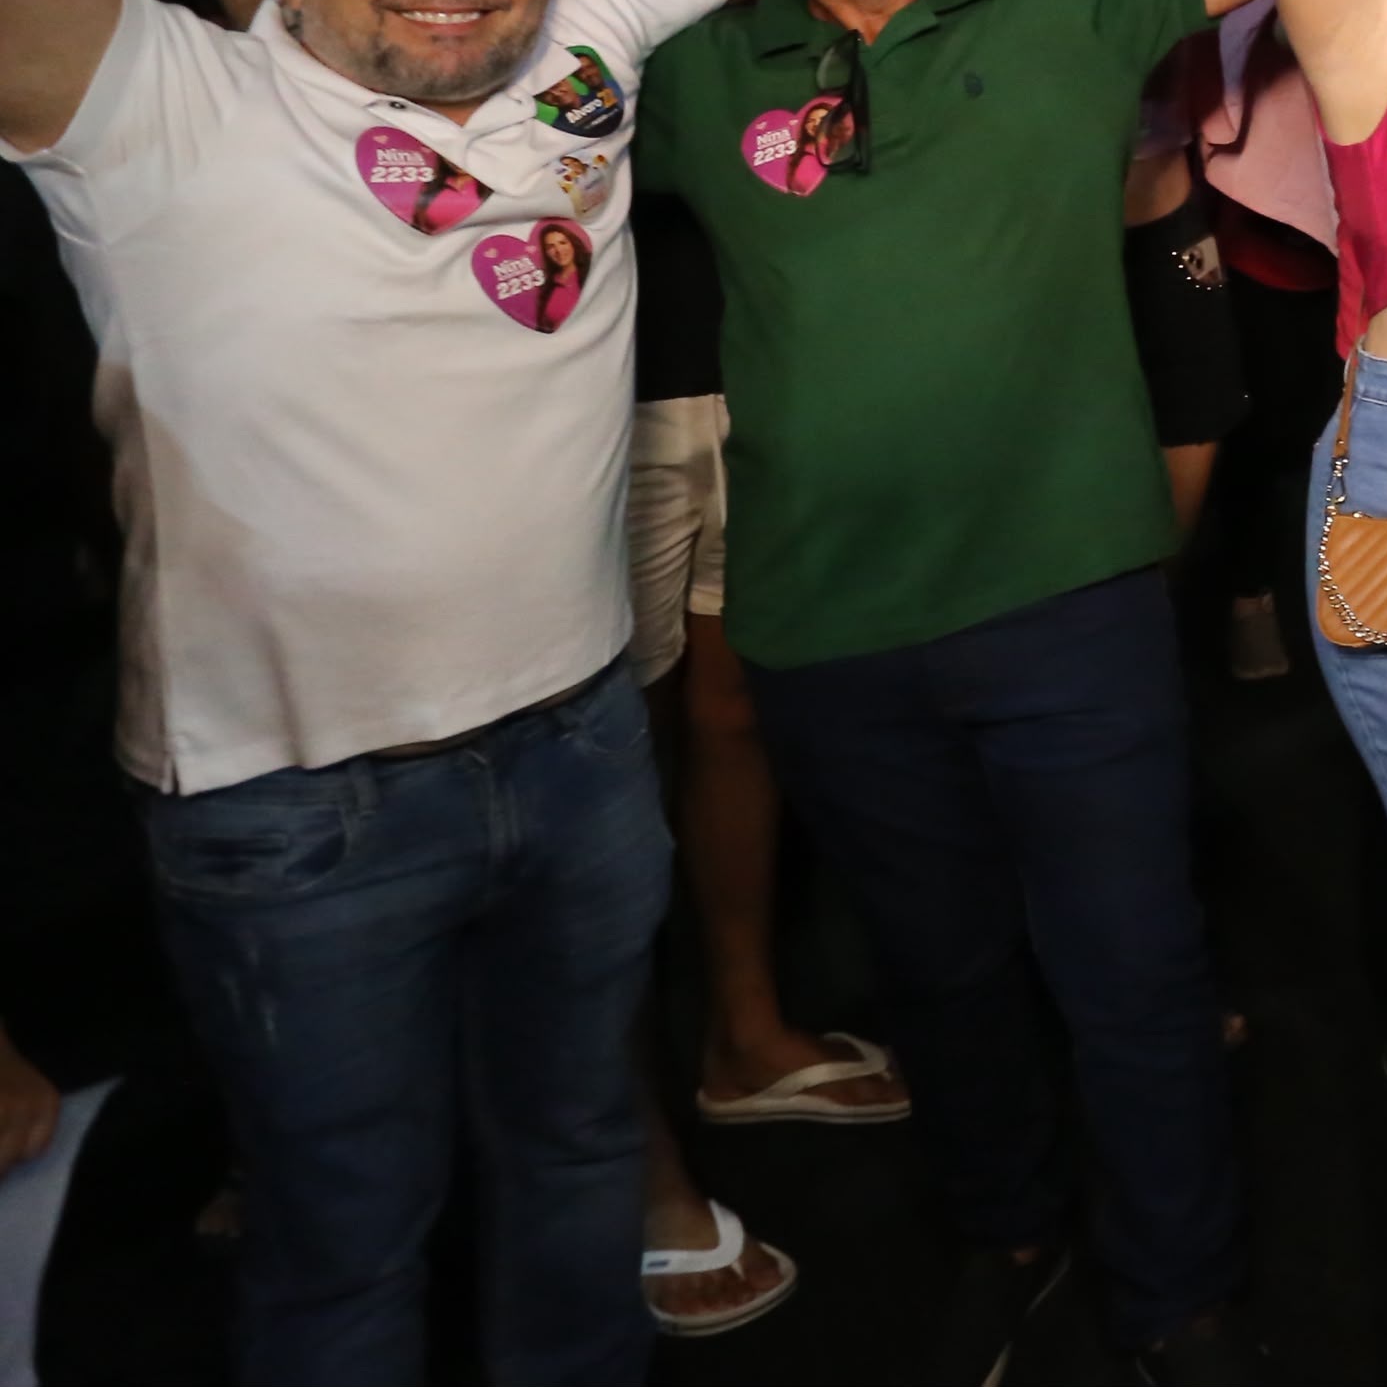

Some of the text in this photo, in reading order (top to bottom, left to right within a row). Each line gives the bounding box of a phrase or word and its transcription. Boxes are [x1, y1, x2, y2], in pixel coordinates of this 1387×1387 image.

[752, 139, 798, 167] 2233
[369, 166, 435, 183] 2233
[496, 269, 546, 300] 2233
